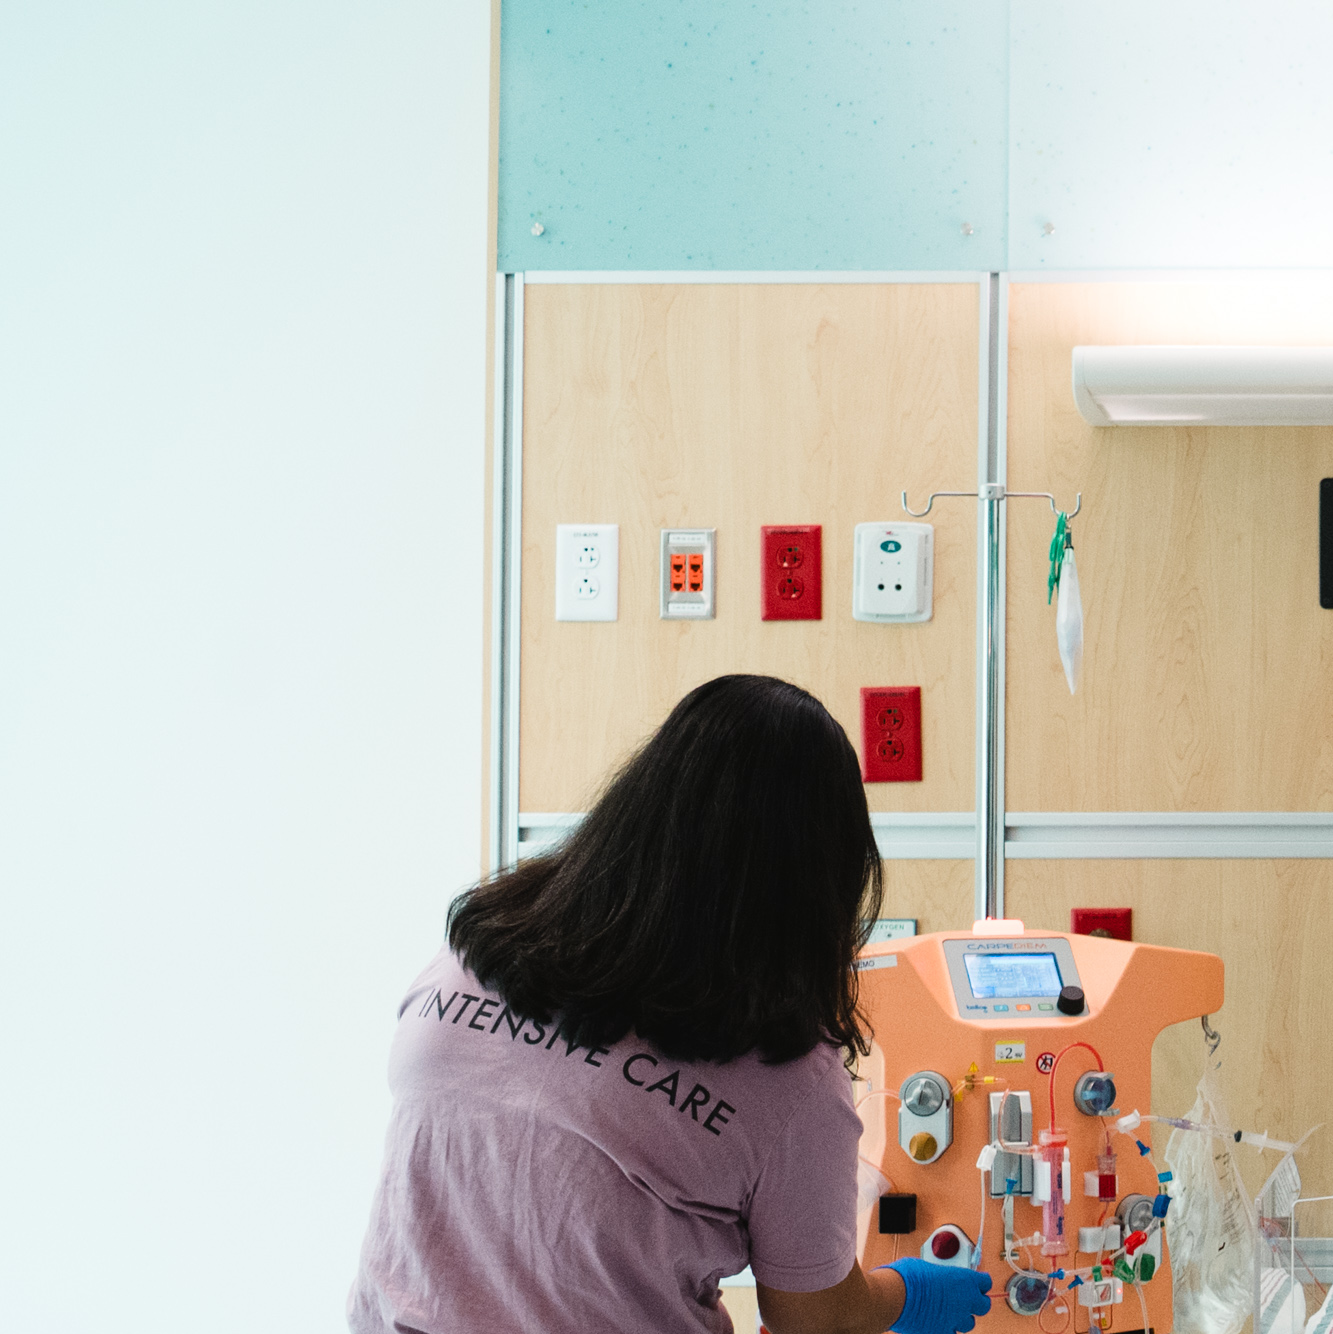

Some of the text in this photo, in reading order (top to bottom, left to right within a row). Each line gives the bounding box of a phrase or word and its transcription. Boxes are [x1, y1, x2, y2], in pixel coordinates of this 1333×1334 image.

[966, 942, 1047, 950] CARPEDIEM
[1005, 1046, 1013, 1059] 2
[622, 1053, 736, 1136] CARE
